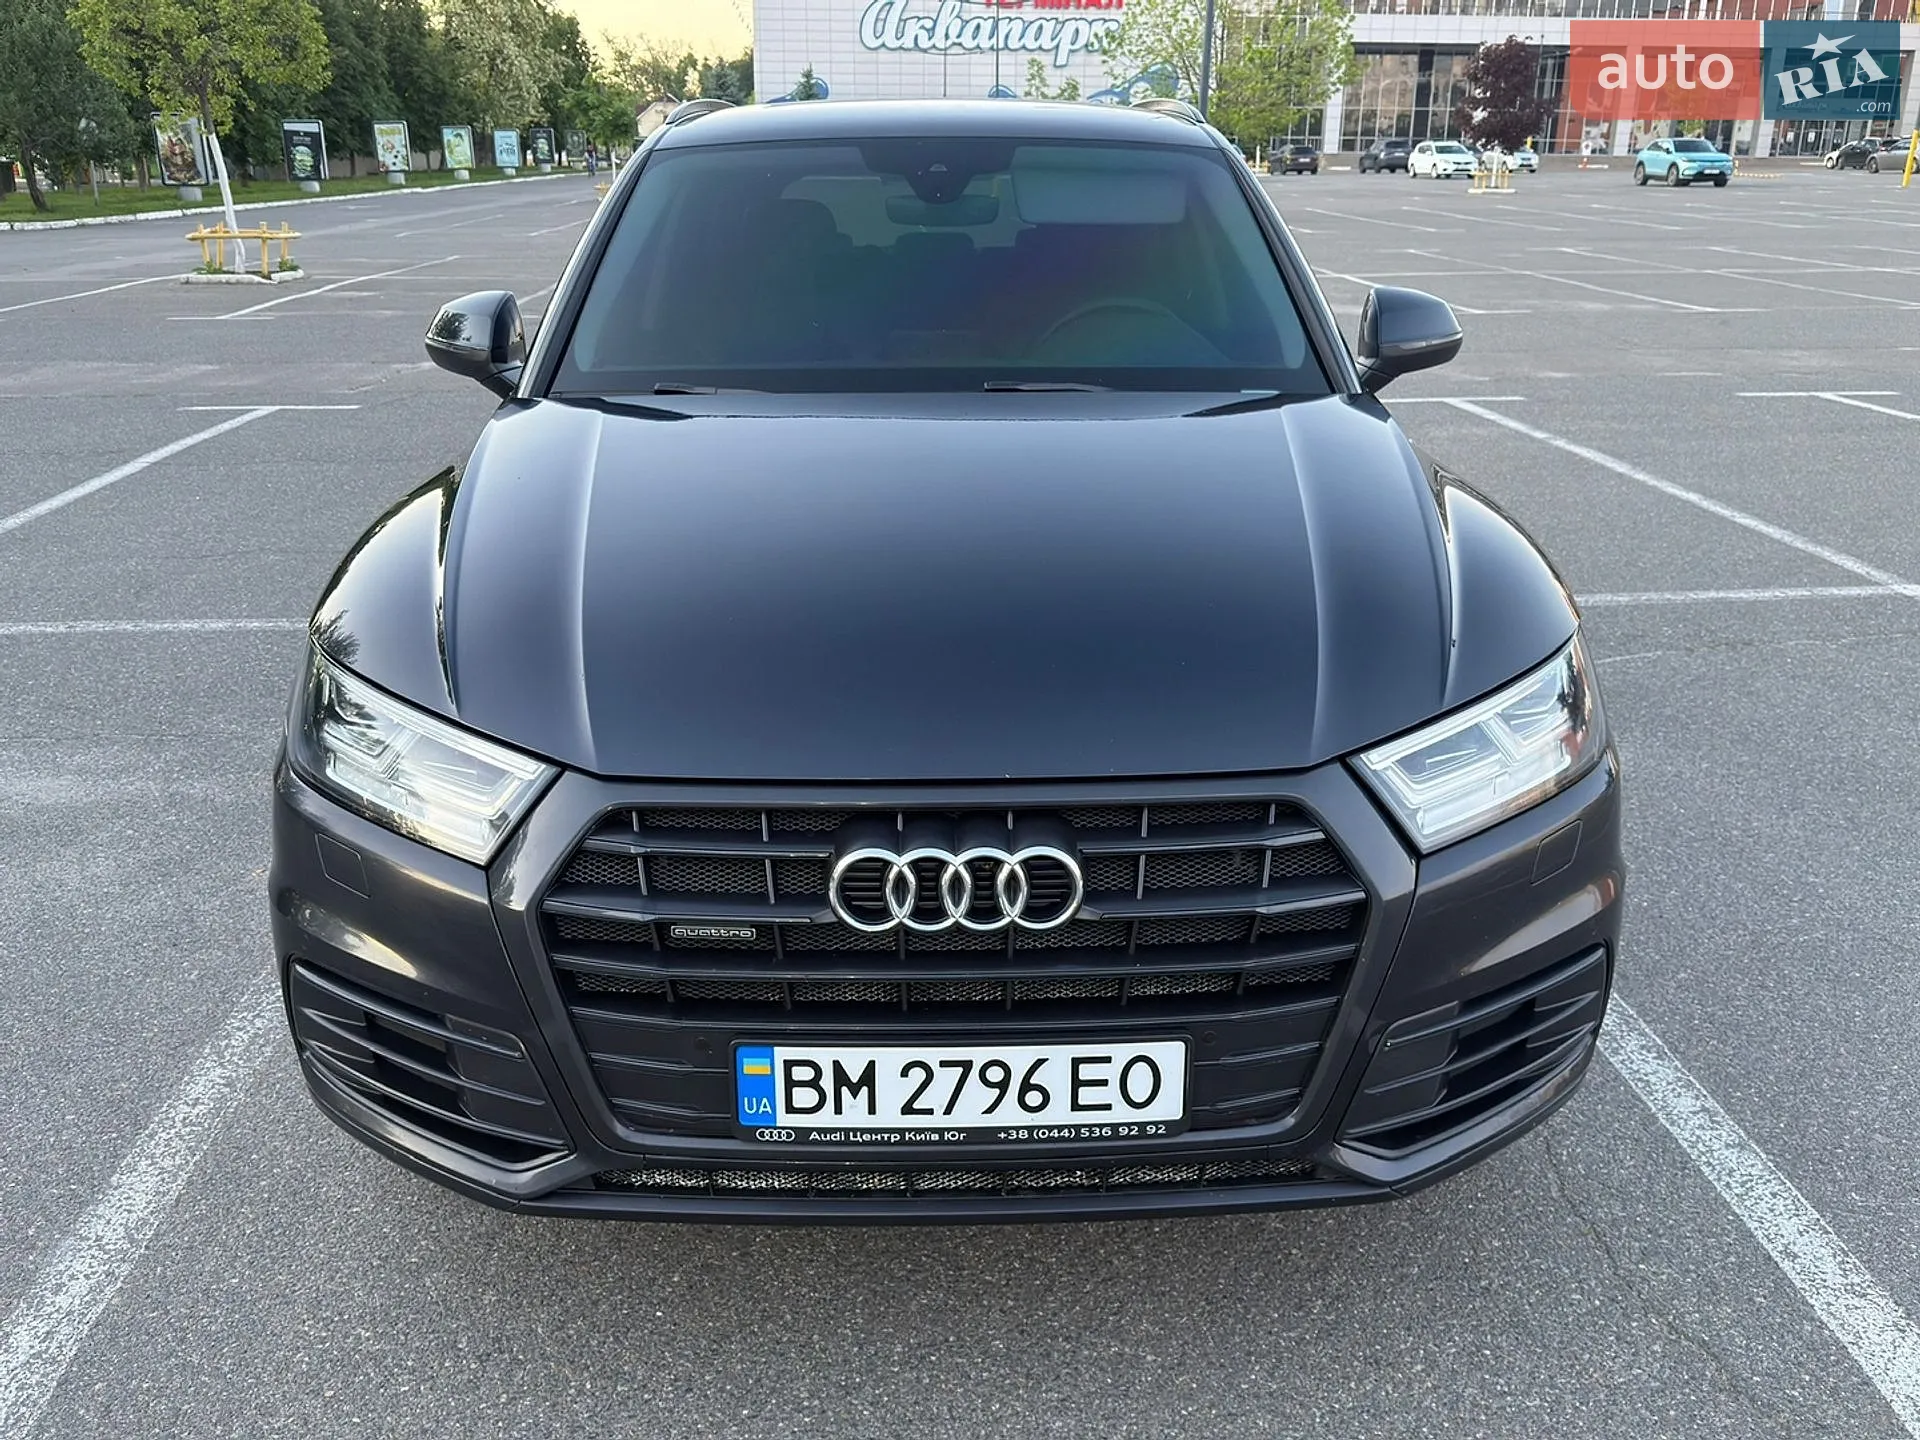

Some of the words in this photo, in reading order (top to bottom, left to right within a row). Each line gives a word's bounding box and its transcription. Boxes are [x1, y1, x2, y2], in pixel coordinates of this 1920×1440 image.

[673, 928, 752, 937] quattro
[783, 1059, 876, 1115] BM
[900, 1058, 1050, 1115] 2796
[1070, 1054, 1162, 1112] EO
[744, 1097, 772, 1114] UA
[809, 1130, 845, 1141] Audi
[850, 1131, 900, 1142] Центр
[905, 1130, 938, 1141] Київ
[944, 1130, 967, 1141] Юг
[997, 1128, 1028, 1139] +38
[1033, 1127, 1076, 1139] (044)
[1080, 1126, 1112, 1137] 536
[1118, 1125, 1139, 1135] 92
[1146, 1124, 1167, 1134] 92
